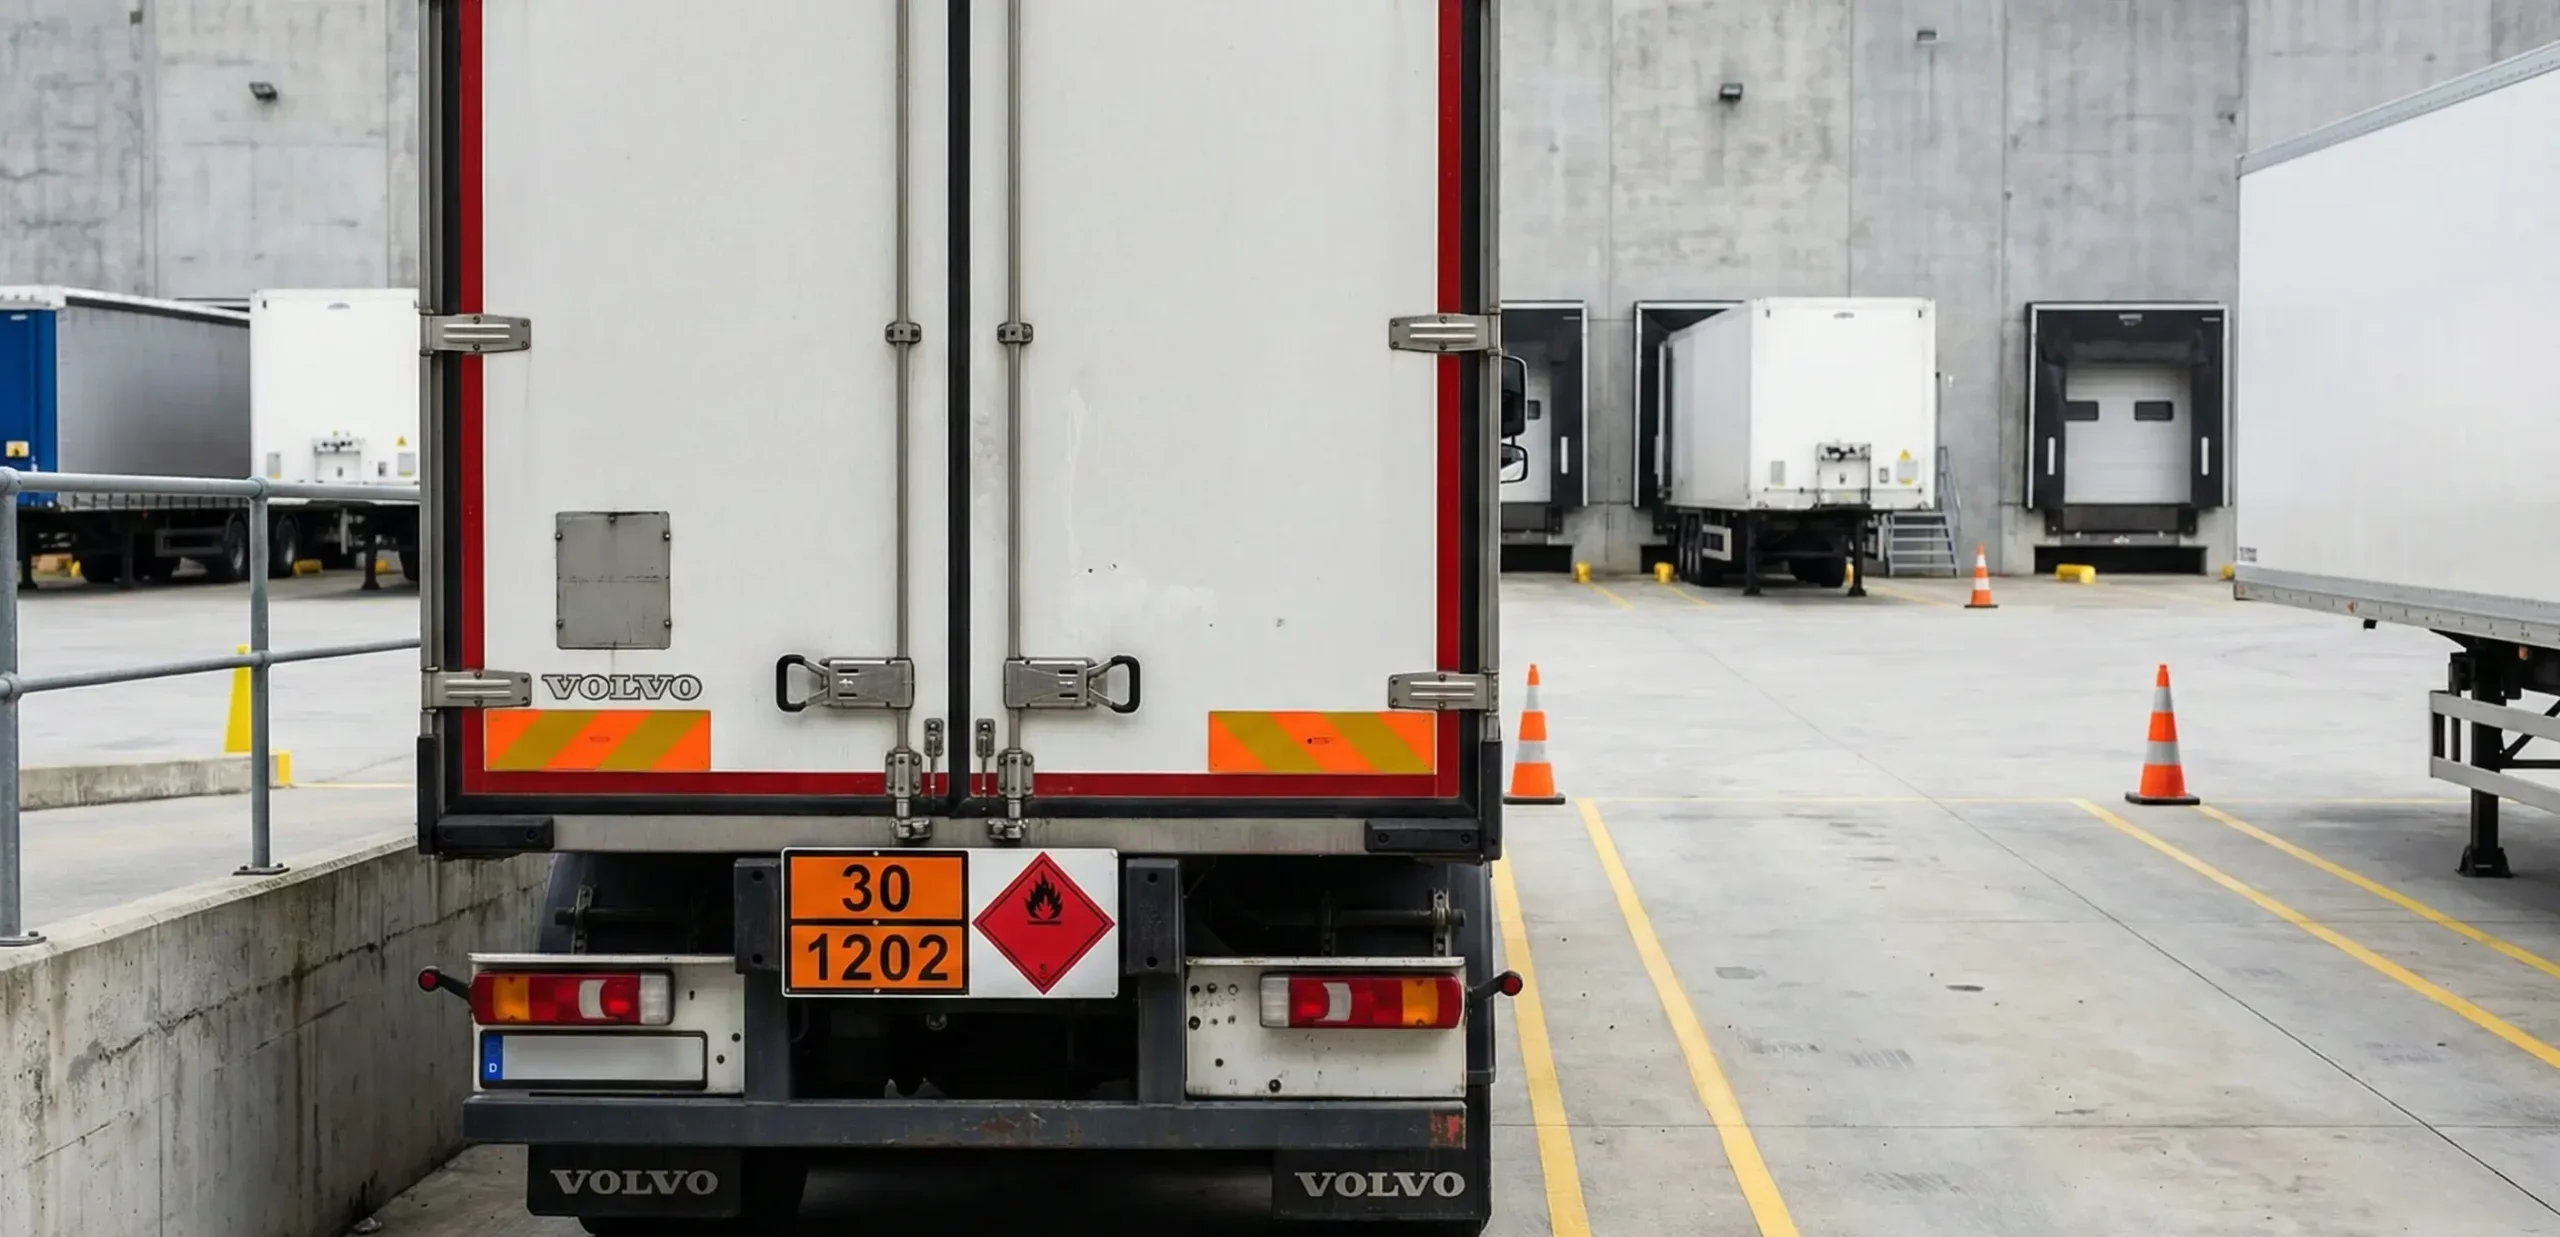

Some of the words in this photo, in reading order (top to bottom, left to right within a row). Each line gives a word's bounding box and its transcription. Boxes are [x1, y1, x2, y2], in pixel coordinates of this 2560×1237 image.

[541, 674, 702, 701] VOLVO
[842, 864, 911, 912] 30
[808, 933, 948, 981] 1202
[489, 1063, 497, 1073] D
[550, 1169, 718, 1195] VOLVO
[1294, 1171, 1466, 1197] VOLVO
